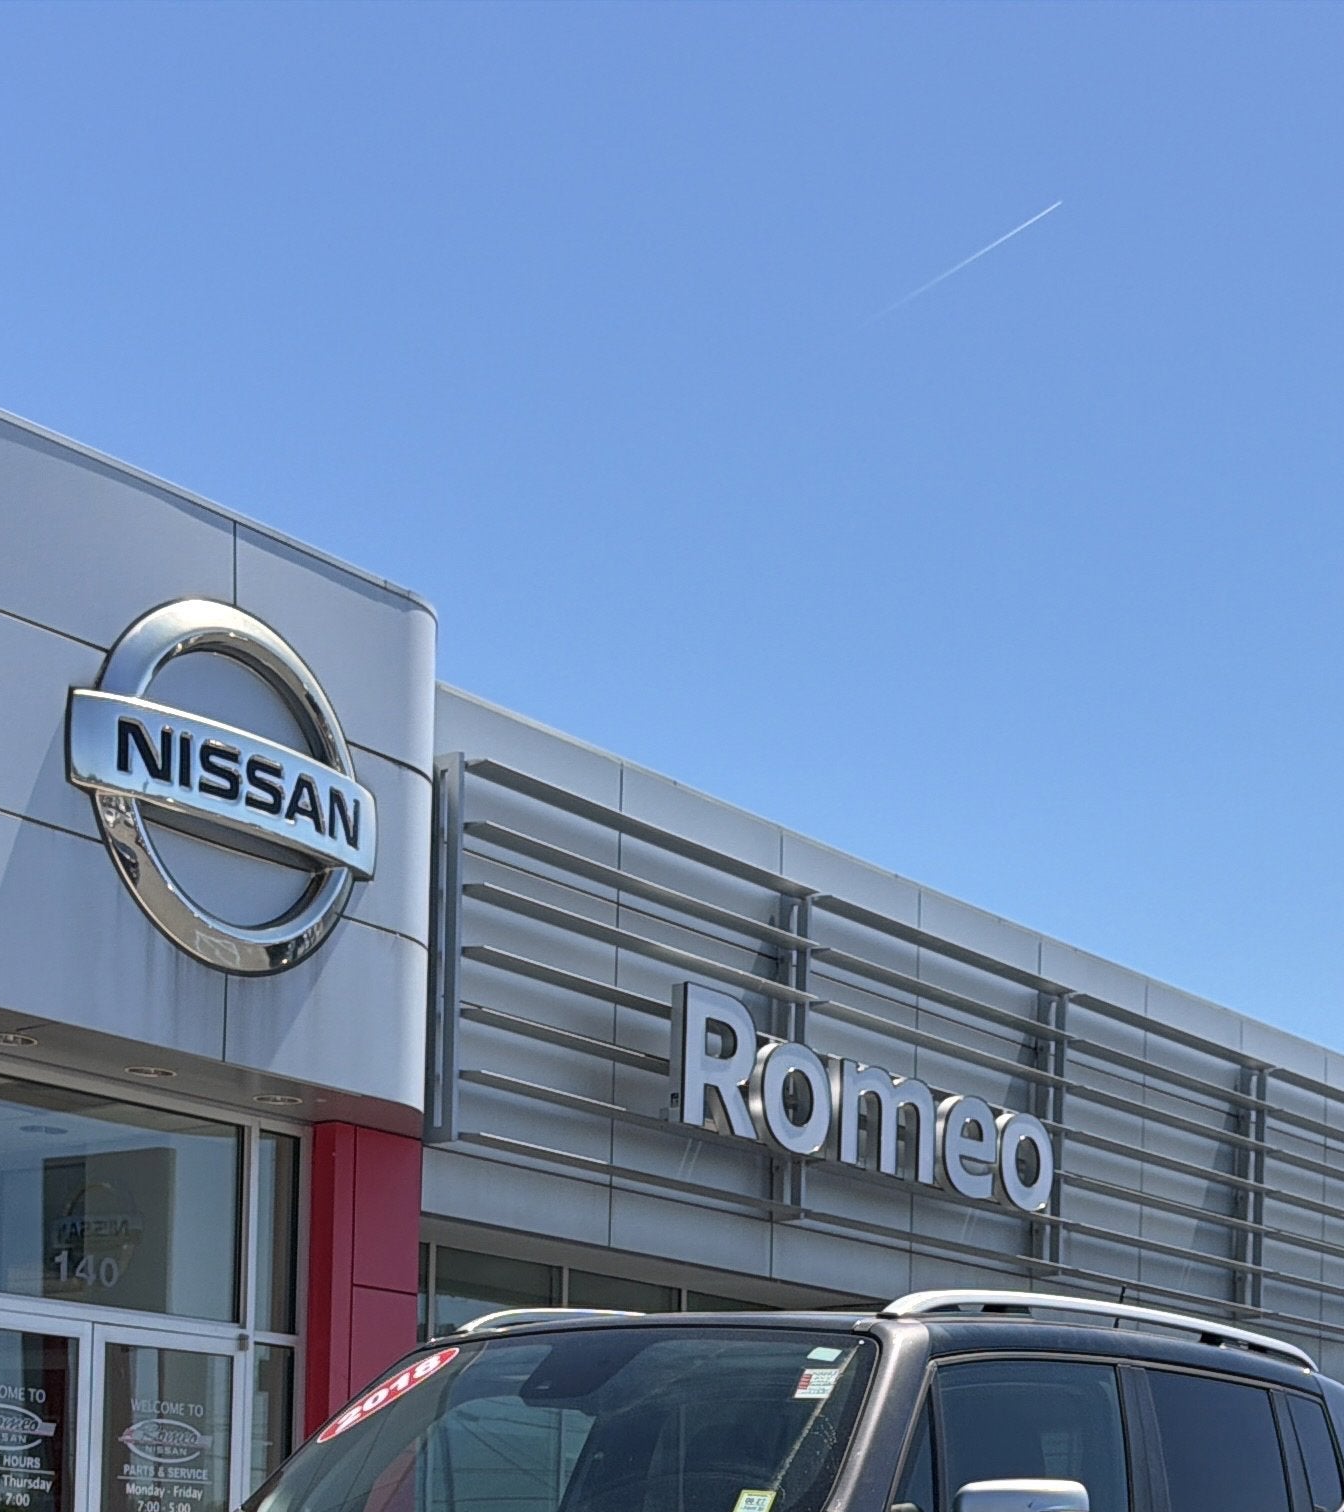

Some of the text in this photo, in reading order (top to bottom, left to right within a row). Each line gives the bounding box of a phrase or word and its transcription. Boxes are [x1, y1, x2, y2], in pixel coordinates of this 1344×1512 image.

[115, 715, 361, 851] NISSAN
[671, 981, 1055, 1213] Romeo
[54, 1250, 119, 1288] 140
[27, 1387, 47, 1404] TO
[333, 1354, 442, 1435] 2018
[130, 1397, 204, 1418] WELCOME TO
[145, 1445, 187, 1456] NISSAN
[2, 1454, 41, 1469] HOURS
[123, 1463, 209, 1480] PARTS & SERVICE
[2, 1474, 53, 1493] Thursday
[125, 1482, 165, 1498] Monday
[173, 1485, 203, 1501] Friday
[5, 1492, 31, 1507] 7:00
